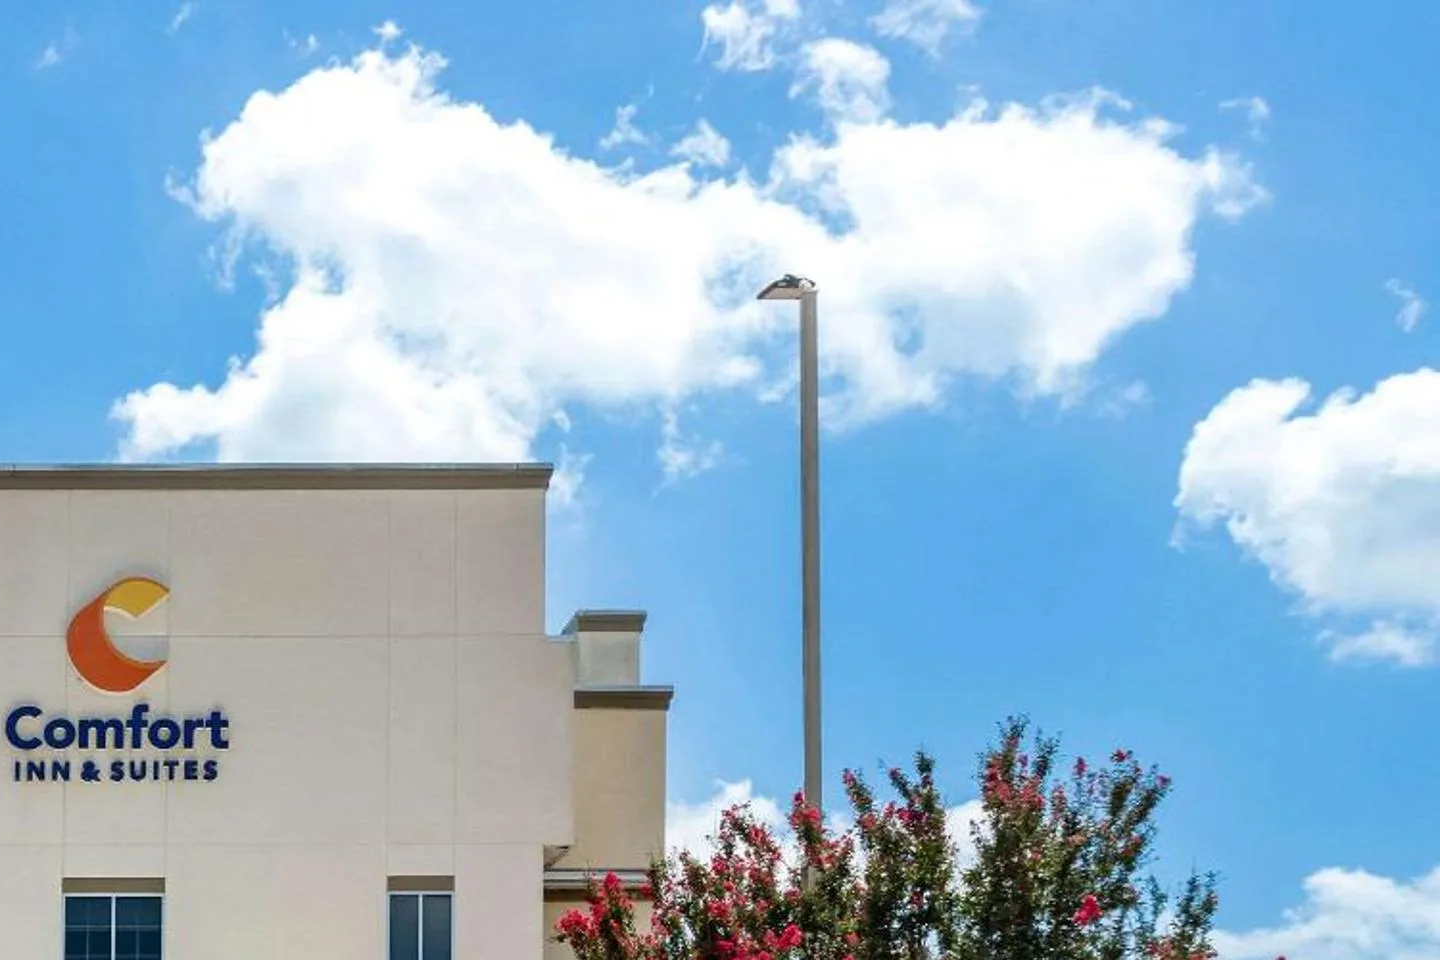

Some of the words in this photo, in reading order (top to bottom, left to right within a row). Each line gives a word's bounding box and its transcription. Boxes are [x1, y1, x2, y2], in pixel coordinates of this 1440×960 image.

[5, 704, 229, 750] Comfort
[14, 760, 70, 781] INN
[81, 760, 101, 781] &
[110, 760, 218, 781] SUITES
